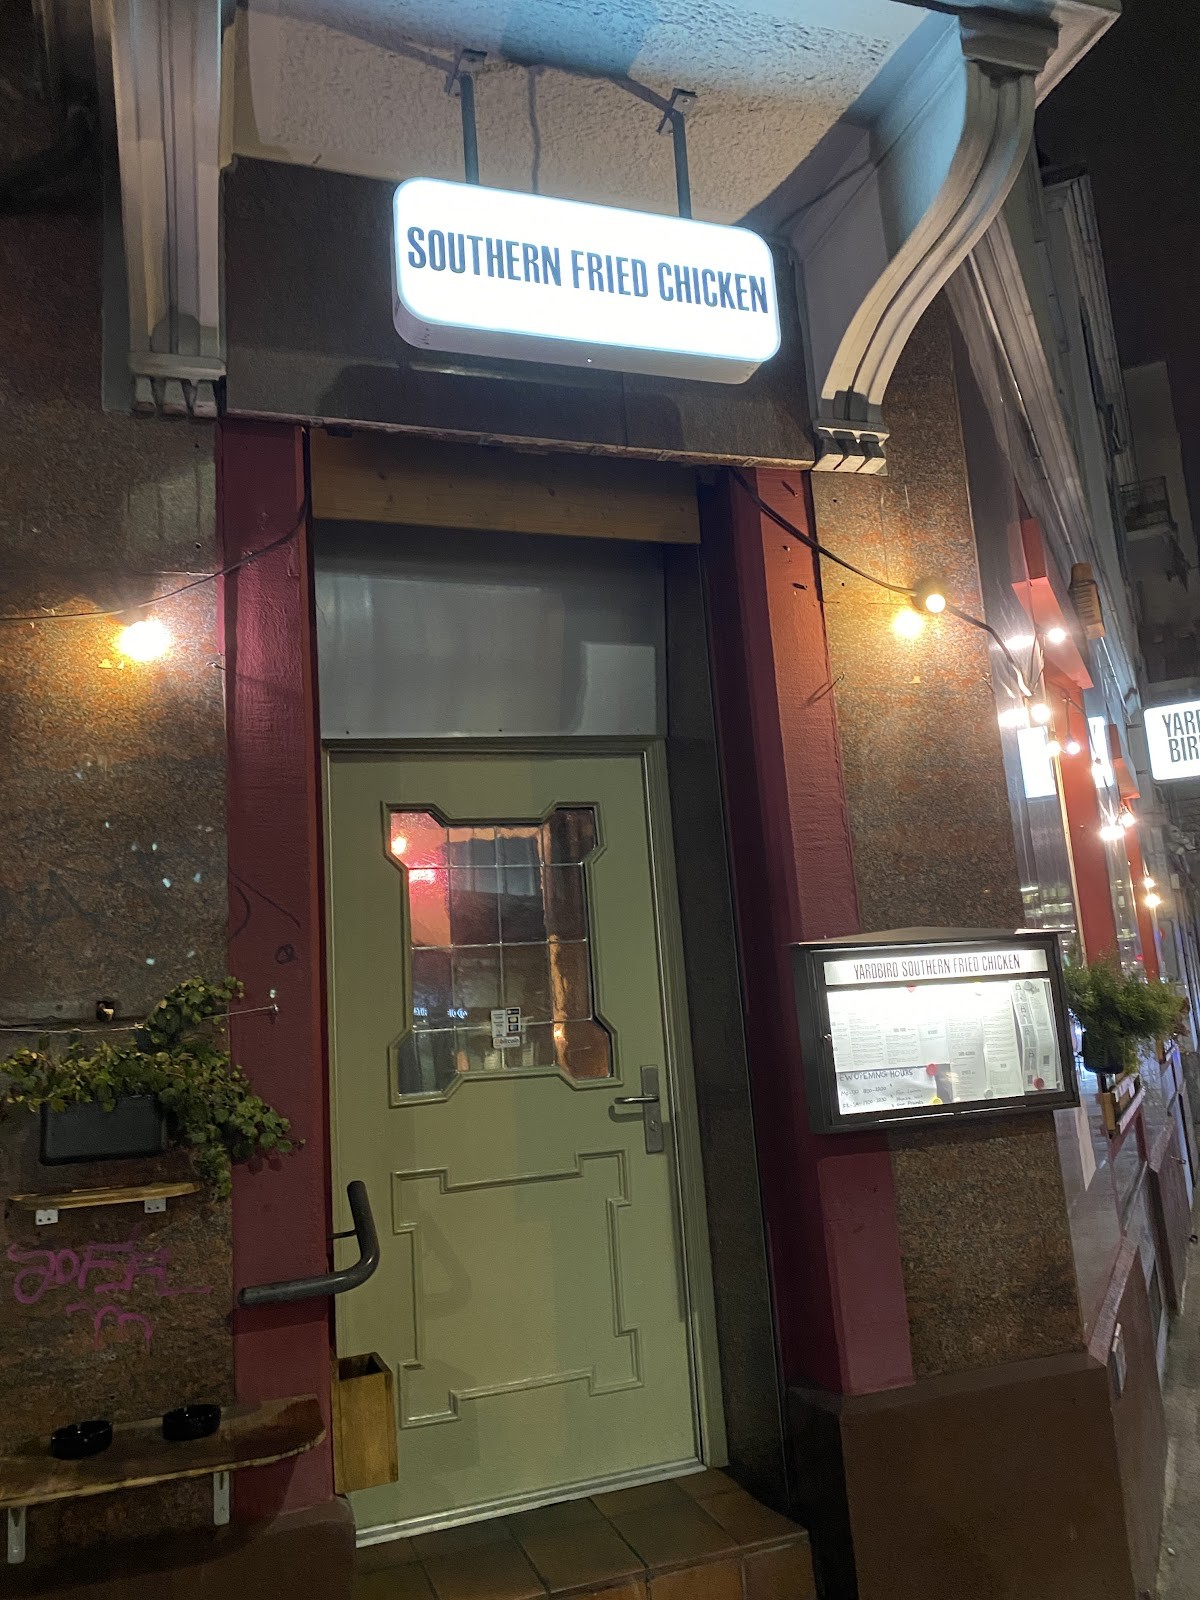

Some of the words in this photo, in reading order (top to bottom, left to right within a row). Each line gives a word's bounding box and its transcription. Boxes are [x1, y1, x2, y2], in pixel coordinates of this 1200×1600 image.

[407, 226, 562, 286] SOUTHERN
[571, 249, 649, 298] FRIED
[657, 262, 769, 313] CHICKEN
[1168, 735, 1200, 763] BIR
[854, 961, 899, 980] YARDBIRD
[901, 958, 951, 977] SOUTHERN
[953, 956, 980, 973] FRIED
[981, 953, 1021, 971] CHICKEN
[890, 1069, 913, 1078] HOURS
